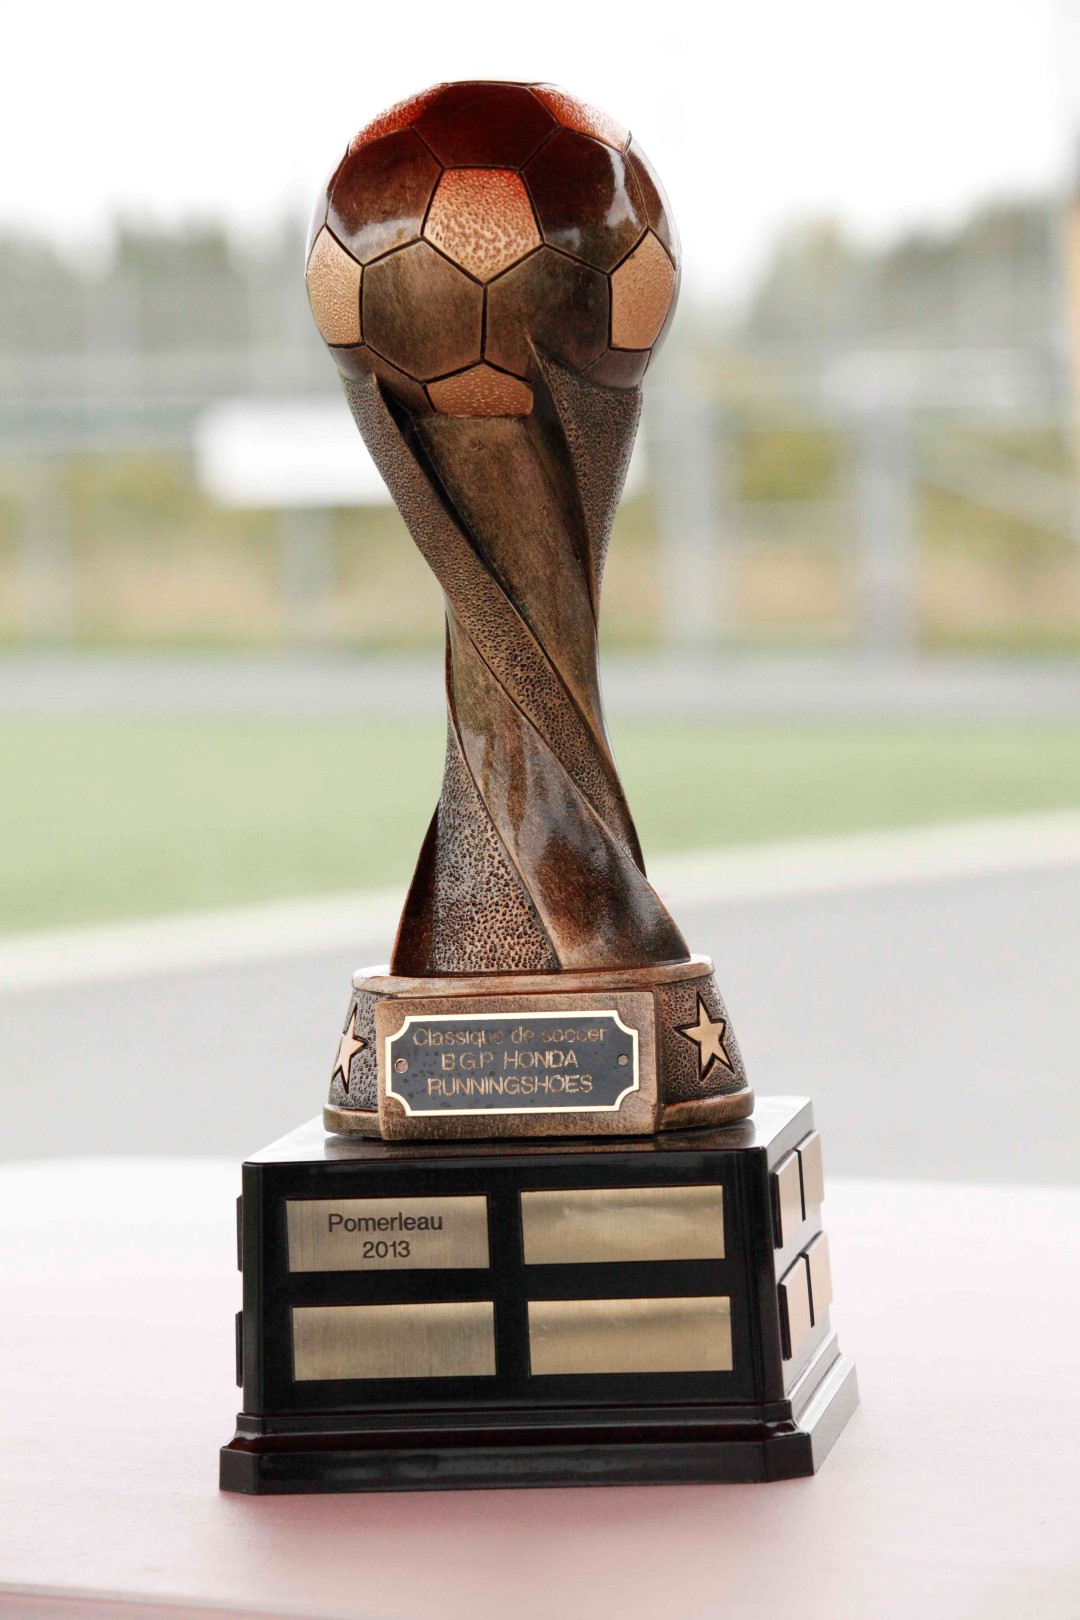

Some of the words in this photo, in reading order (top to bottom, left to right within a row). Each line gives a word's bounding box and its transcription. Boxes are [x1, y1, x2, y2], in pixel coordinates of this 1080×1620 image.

[412, 1028, 503, 1047] Classique
[511, 1026, 534, 1044] de
[542, 1027, 607, 1043] soccer
[503, 1050, 579, 1070] HONDA
[427, 1075, 593, 1096] RUNNINGSHOES
[328, 1212, 443, 1232] Pomerleau
[362, 1240, 411, 1258] 2013
